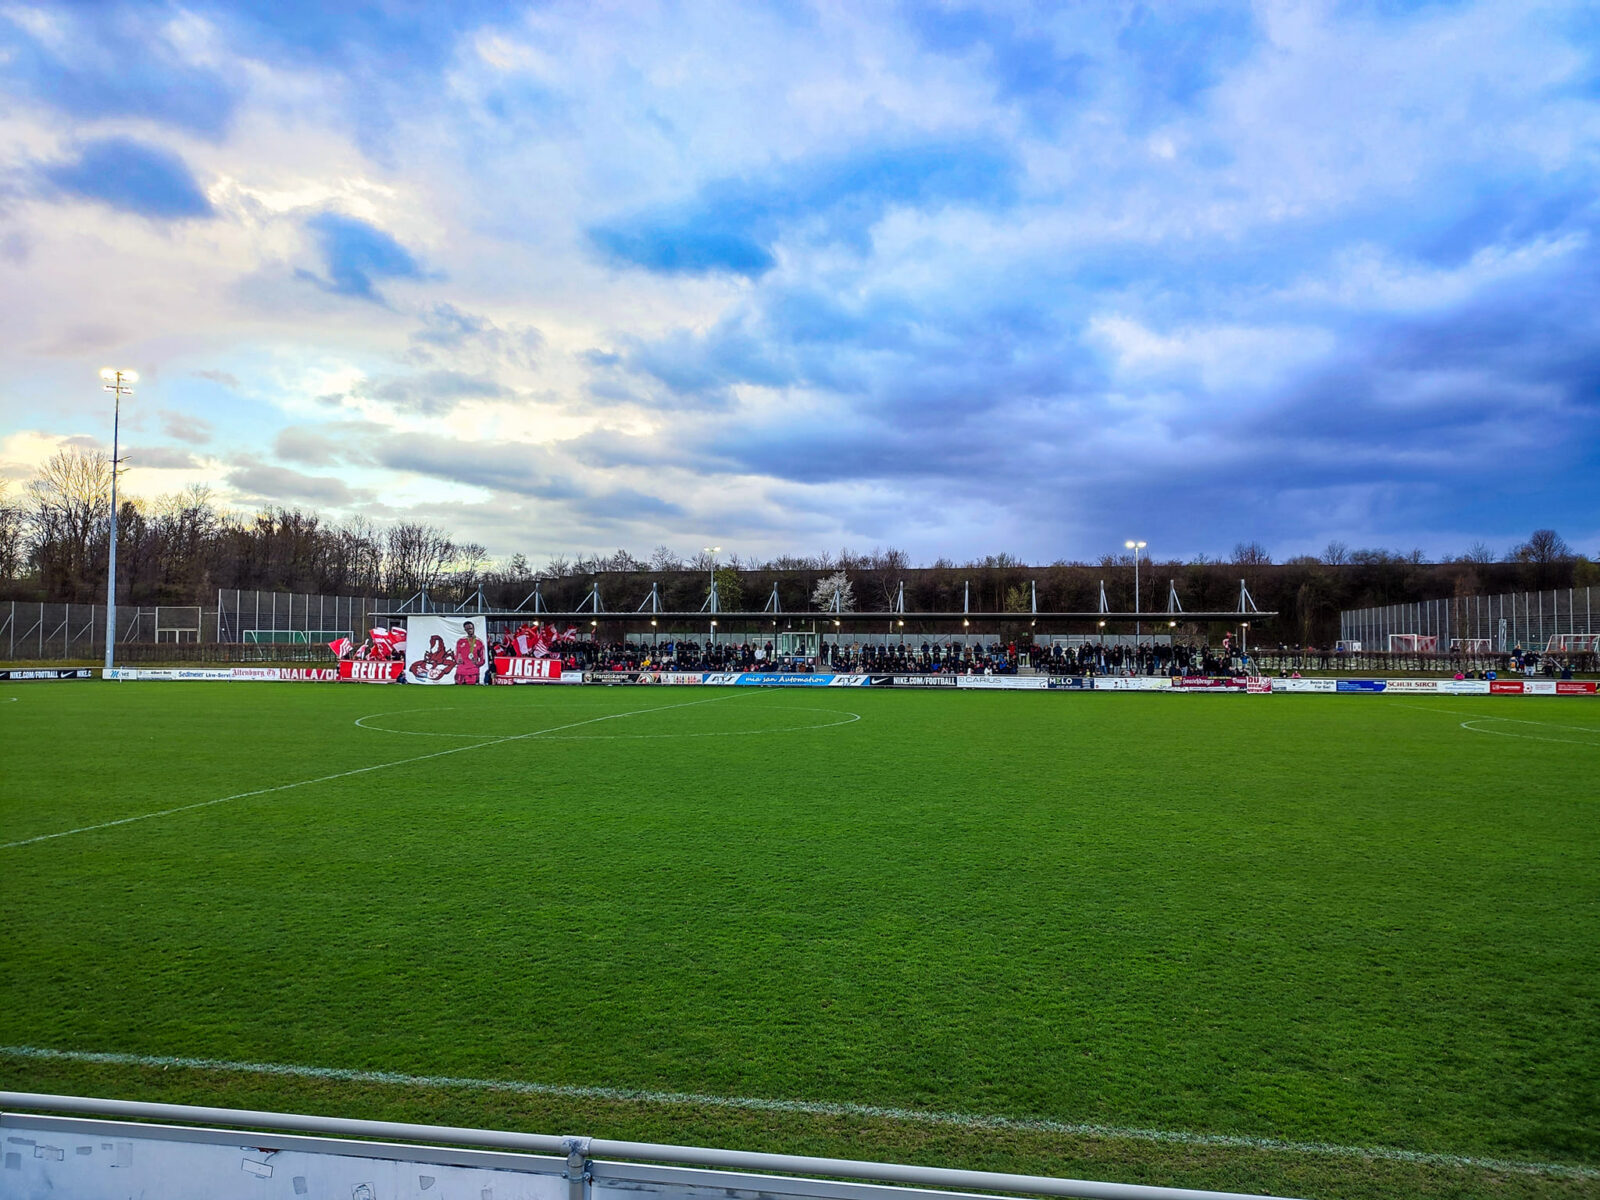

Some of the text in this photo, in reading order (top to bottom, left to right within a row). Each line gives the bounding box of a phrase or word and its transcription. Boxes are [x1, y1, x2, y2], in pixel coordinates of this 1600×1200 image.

[351, 662, 392, 680] BEUTE
[506, 659, 550, 677] JAGEN
[9, 671, 59, 679] NIKE.COM/FOOTBALL
[777, 675, 825, 684] Automation
[893, 676, 956, 685] NIKE.COM/FOOTBALL
